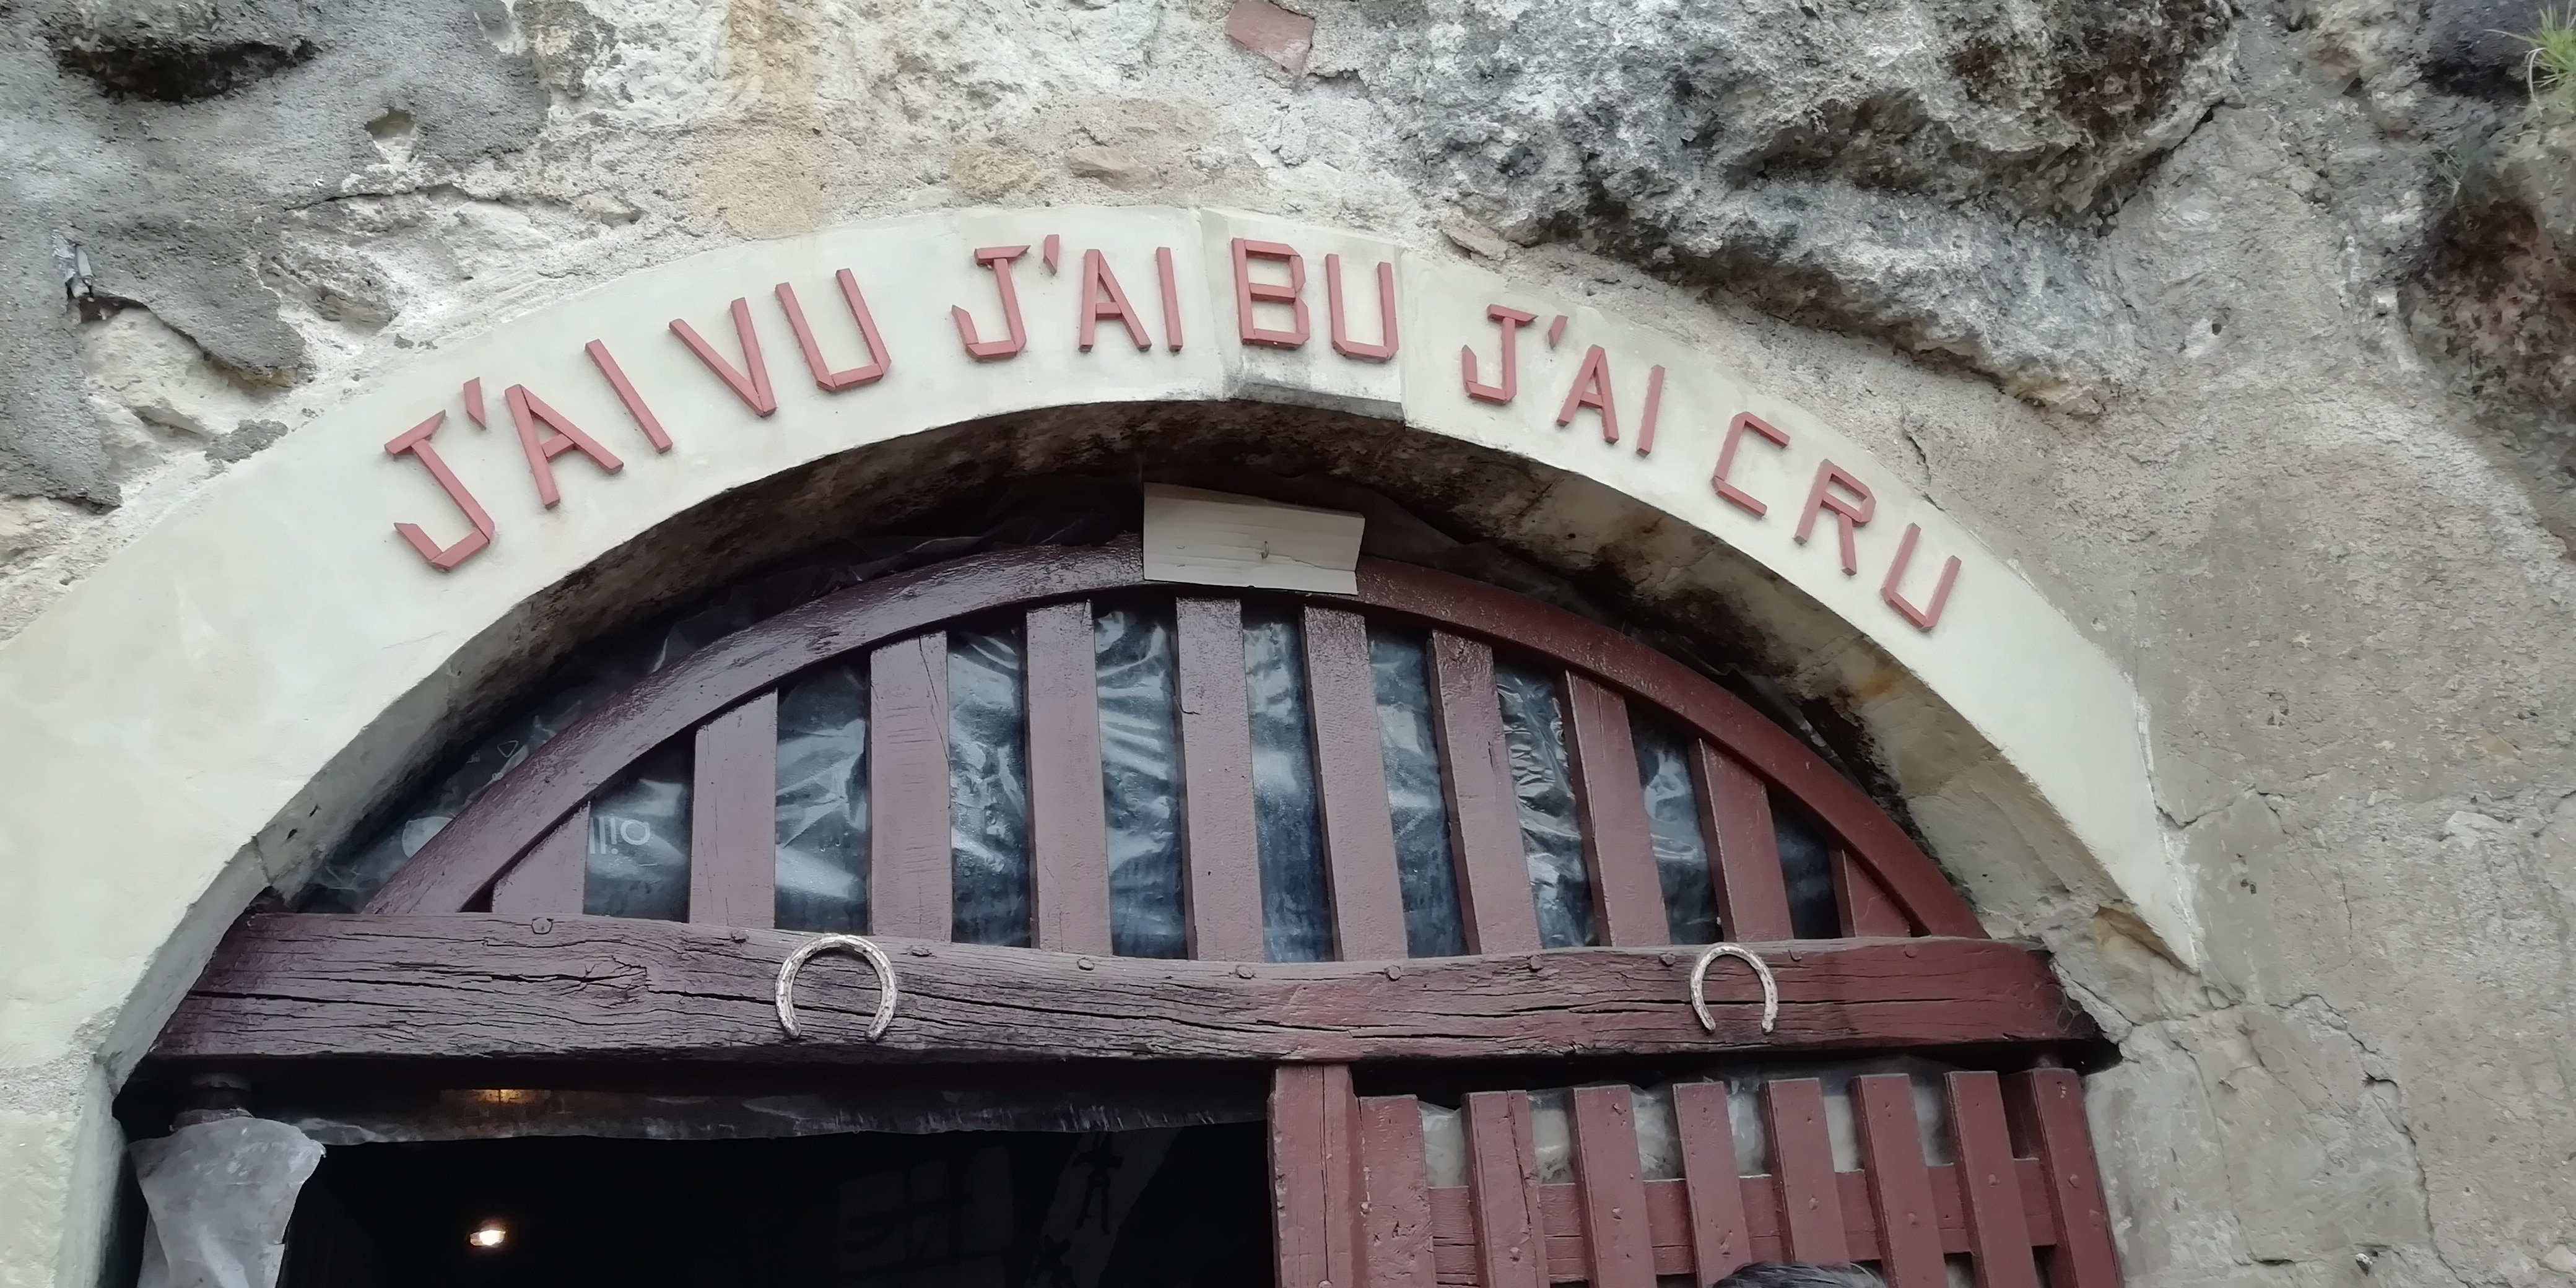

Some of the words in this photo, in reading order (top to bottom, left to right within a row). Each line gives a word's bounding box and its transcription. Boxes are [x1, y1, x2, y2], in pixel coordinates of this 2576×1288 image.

[382, 338, 674, 573] J'AI
[669, 267, 891, 416] VU
[952, 235, 1183, 360] J'AI
[1229, 238, 1398, 360] BU
[1461, 303, 1664, 456] J'AI
[1712, 411, 1962, 631] CRU
